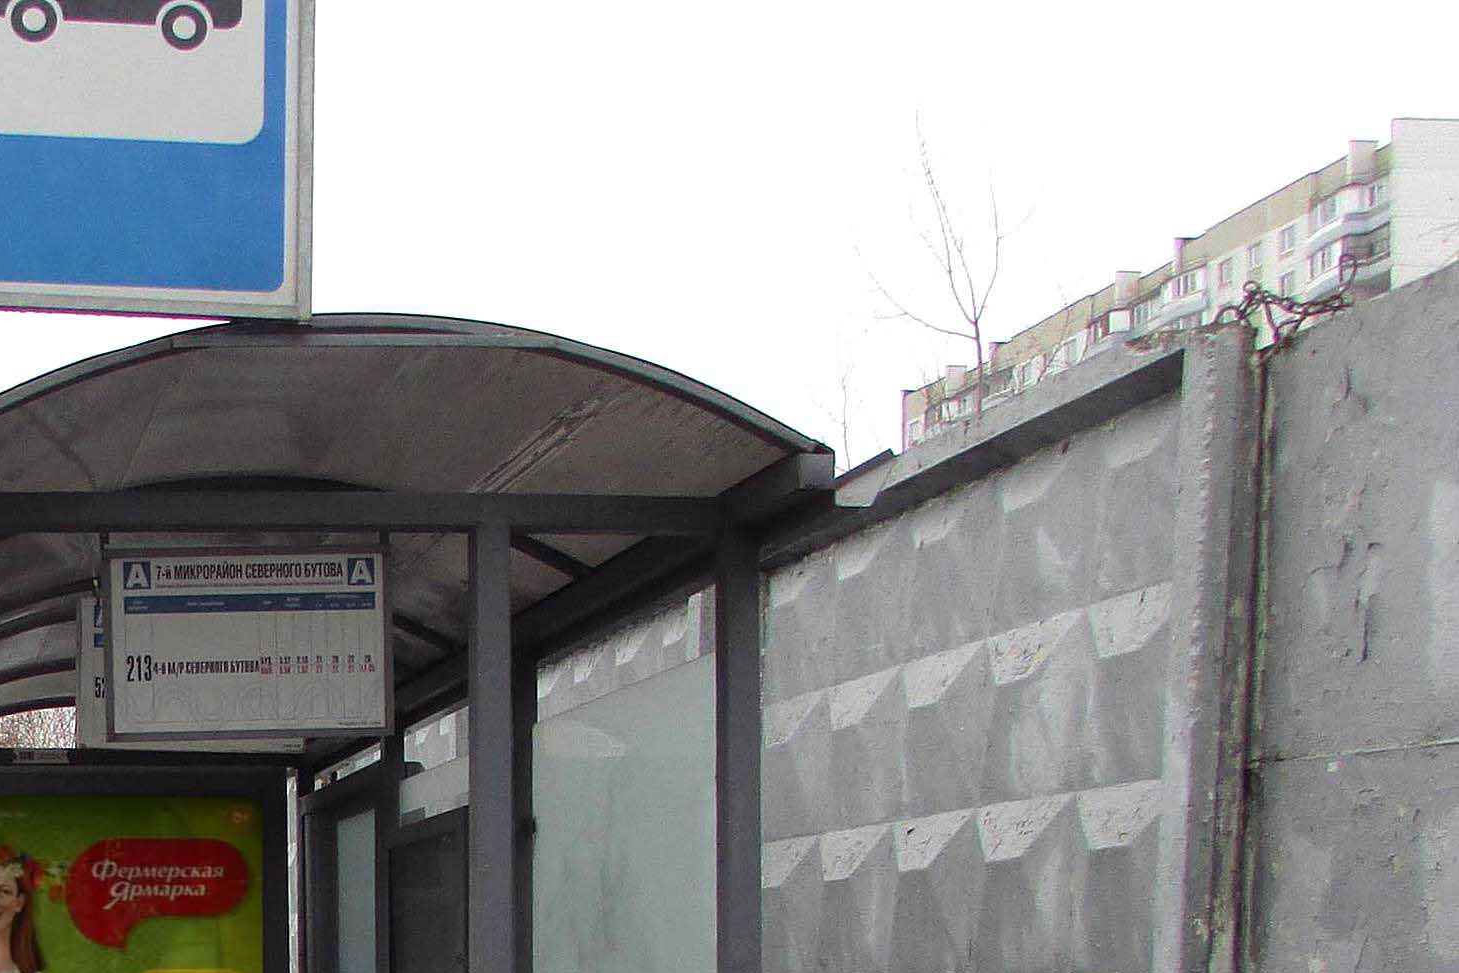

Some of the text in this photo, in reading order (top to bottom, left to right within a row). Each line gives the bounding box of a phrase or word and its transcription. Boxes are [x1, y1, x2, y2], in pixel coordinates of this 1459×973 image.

[174, 562, 242, 580] МИКРОРАЙОН
[245, 562, 302, 579] СЕВЕРНОГО
[304, 562, 343, 577] БУТОВА
[127, 656, 151, 681] 213
[91, 858, 225, 882] Фермерская
[102, 880, 206, 910] Ярмарка
